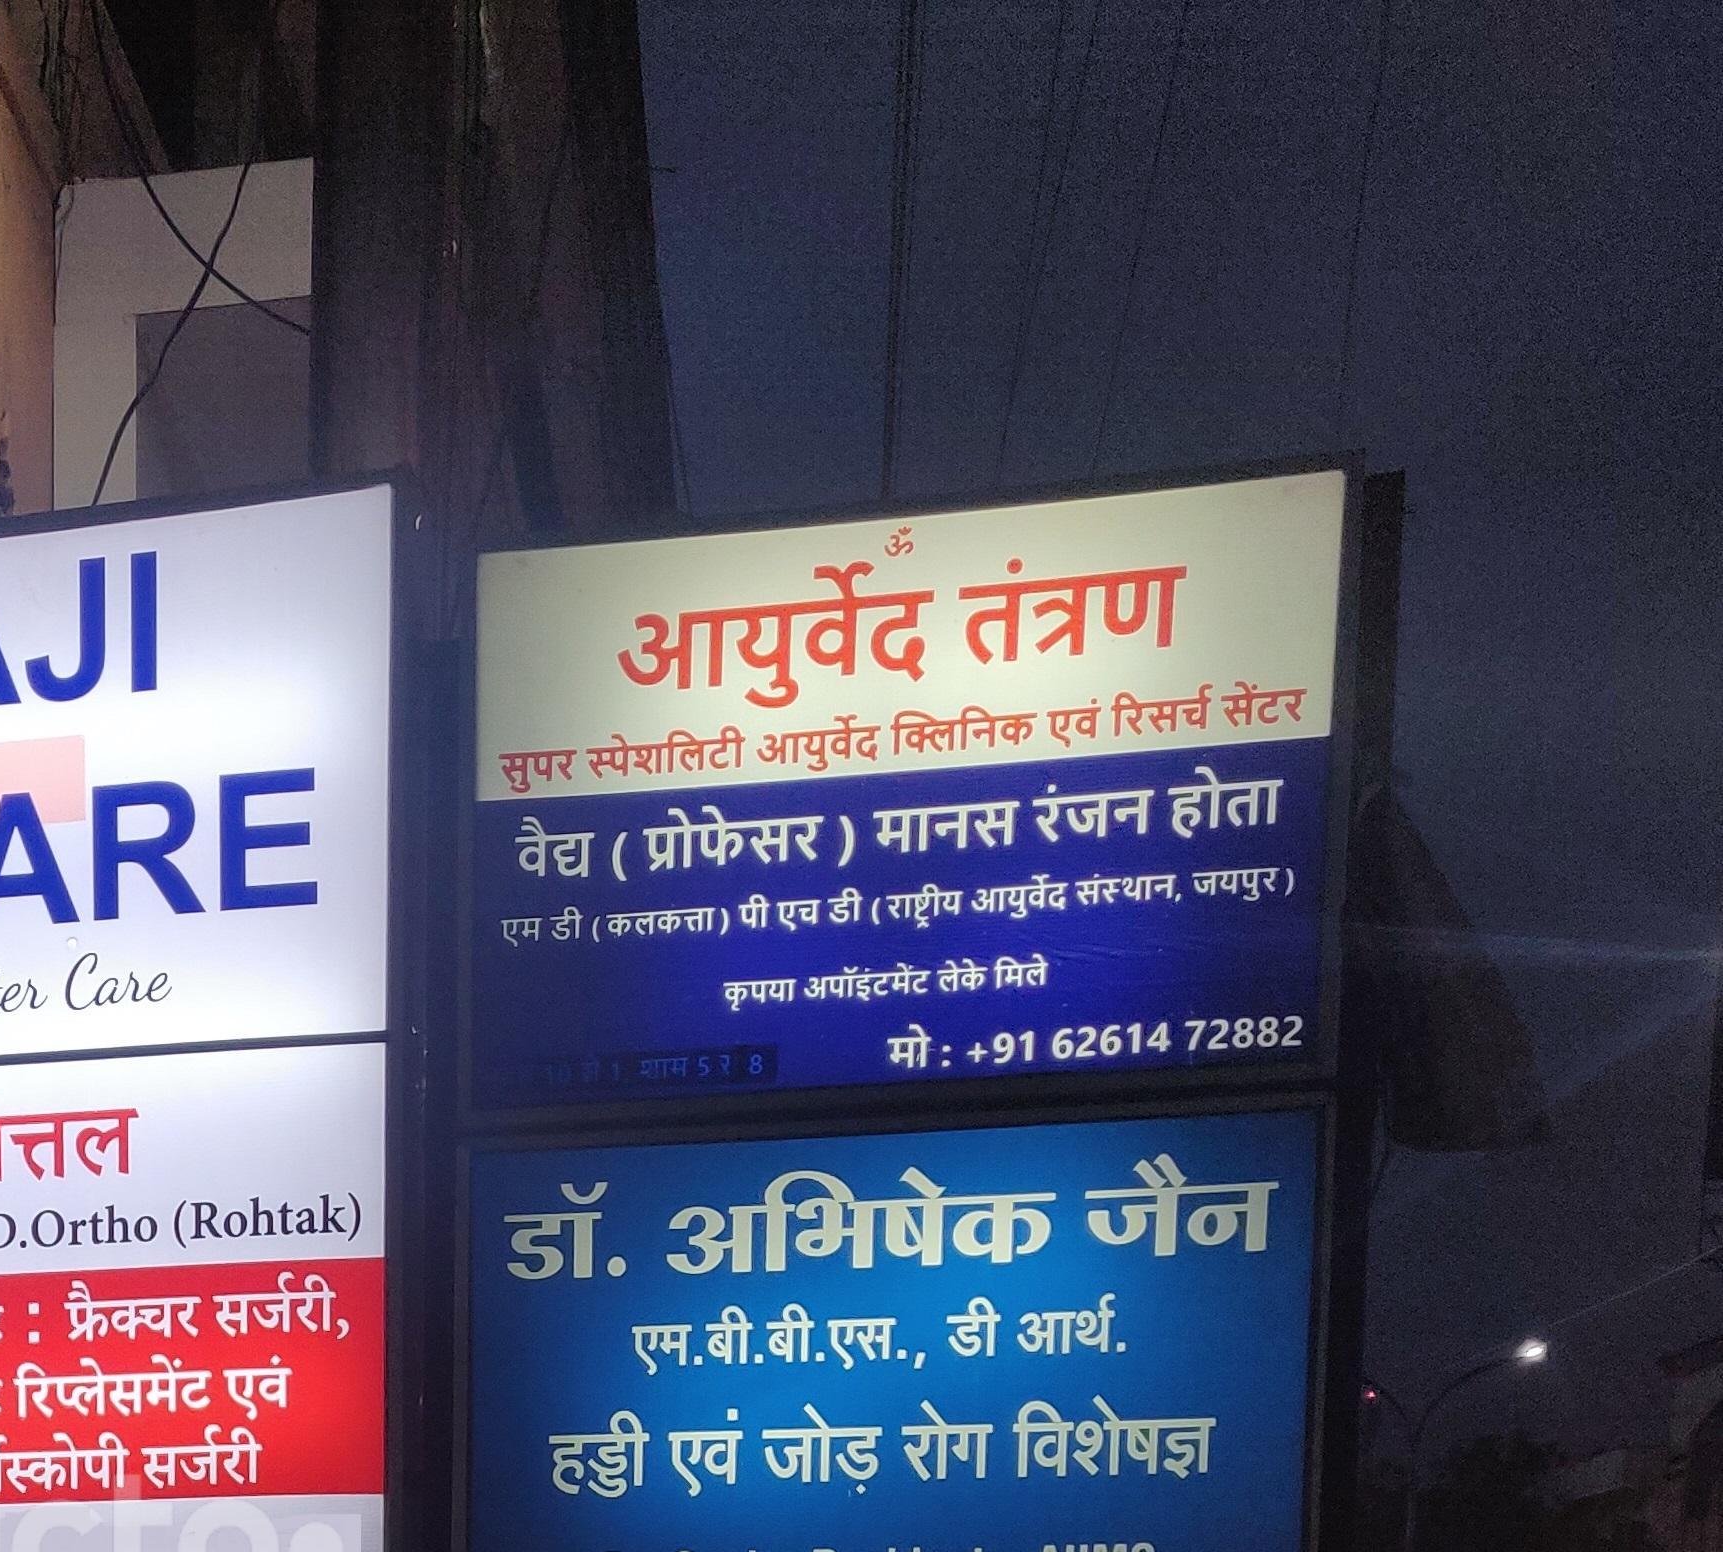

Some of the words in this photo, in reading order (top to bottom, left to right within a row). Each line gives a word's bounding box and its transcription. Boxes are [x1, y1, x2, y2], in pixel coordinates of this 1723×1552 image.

[617, 560, 935, 709] आयुर्वेद
[958, 558, 1188, 665] तंत्रण
[497, 749, 578, 794] सुपर
[584, 725, 746, 780] स्पेशलिटी
[756, 714, 882, 772] आयुर्वेद
[889, 705, 1038, 756] क्लिनिक
[1046, 706, 1102, 748] एवं
[1110, 683, 1214, 737] रिसर्च
[1220, 681, 1308, 728] सेंटर
[514, 816, 596, 878] वैद्य
[872, 800, 1021, 854] मानस
[1032, 783, 1155, 843] रंजन
[1167, 765, 1284, 839] होता
[500, 917, 543, 948] एम
[549, 906, 584, 941] डी
[737, 893, 771, 929] पी
[776, 899, 822, 932] एच
[827, 887, 863, 924] डी
[970, 873, 1069, 919] आयुर्वेद
[1074, 873, 1182, 906] संस्थान,
[64, 952, 173, 1011] Care
[722, 978, 797, 1012] कृपया
[803, 962, 932, 1002] अपॉइंटमेंट
[936, 957, 989, 993] लेके
[993, 953, 1049, 989] मिले
[747, 1053, 764, 1075] 8
[966, 1030, 1035, 1064] +91
[1051, 1022, 1172, 1060] 62614
[1184, 1015, 1303, 1052] 72882
[173, 1192, 361, 1249] (Rohtak)
[503, 1181, 627, 1280] डॉ.
[666, 1166, 1057, 1275] अभिषेक
[1084, 1153, 1280, 1257] जैन
[63, 1280, 202, 1342] फ्रैक्चर
[212, 1271, 350, 1340] सर्जरी,
[631, 1303, 926, 1376] एम.बी.बी.एस.,
[946, 1296, 1002, 1357] डी
[1016, 1292, 1126, 1355] आर्थ.
[12, 1353, 213, 1418] रिप्लेसमेंट
[222, 1355, 293, 1421] एवं
[140, 1424, 263, 1489] सर्जरी
[548, 1410, 651, 1498] हड्डी
[667, 1408, 744, 1497] एवं
[761, 1402, 883, 1495] जोड़
[900, 1399, 994, 1482] रोग
[1011, 1394, 1217, 1479] विशेषज्ञ
